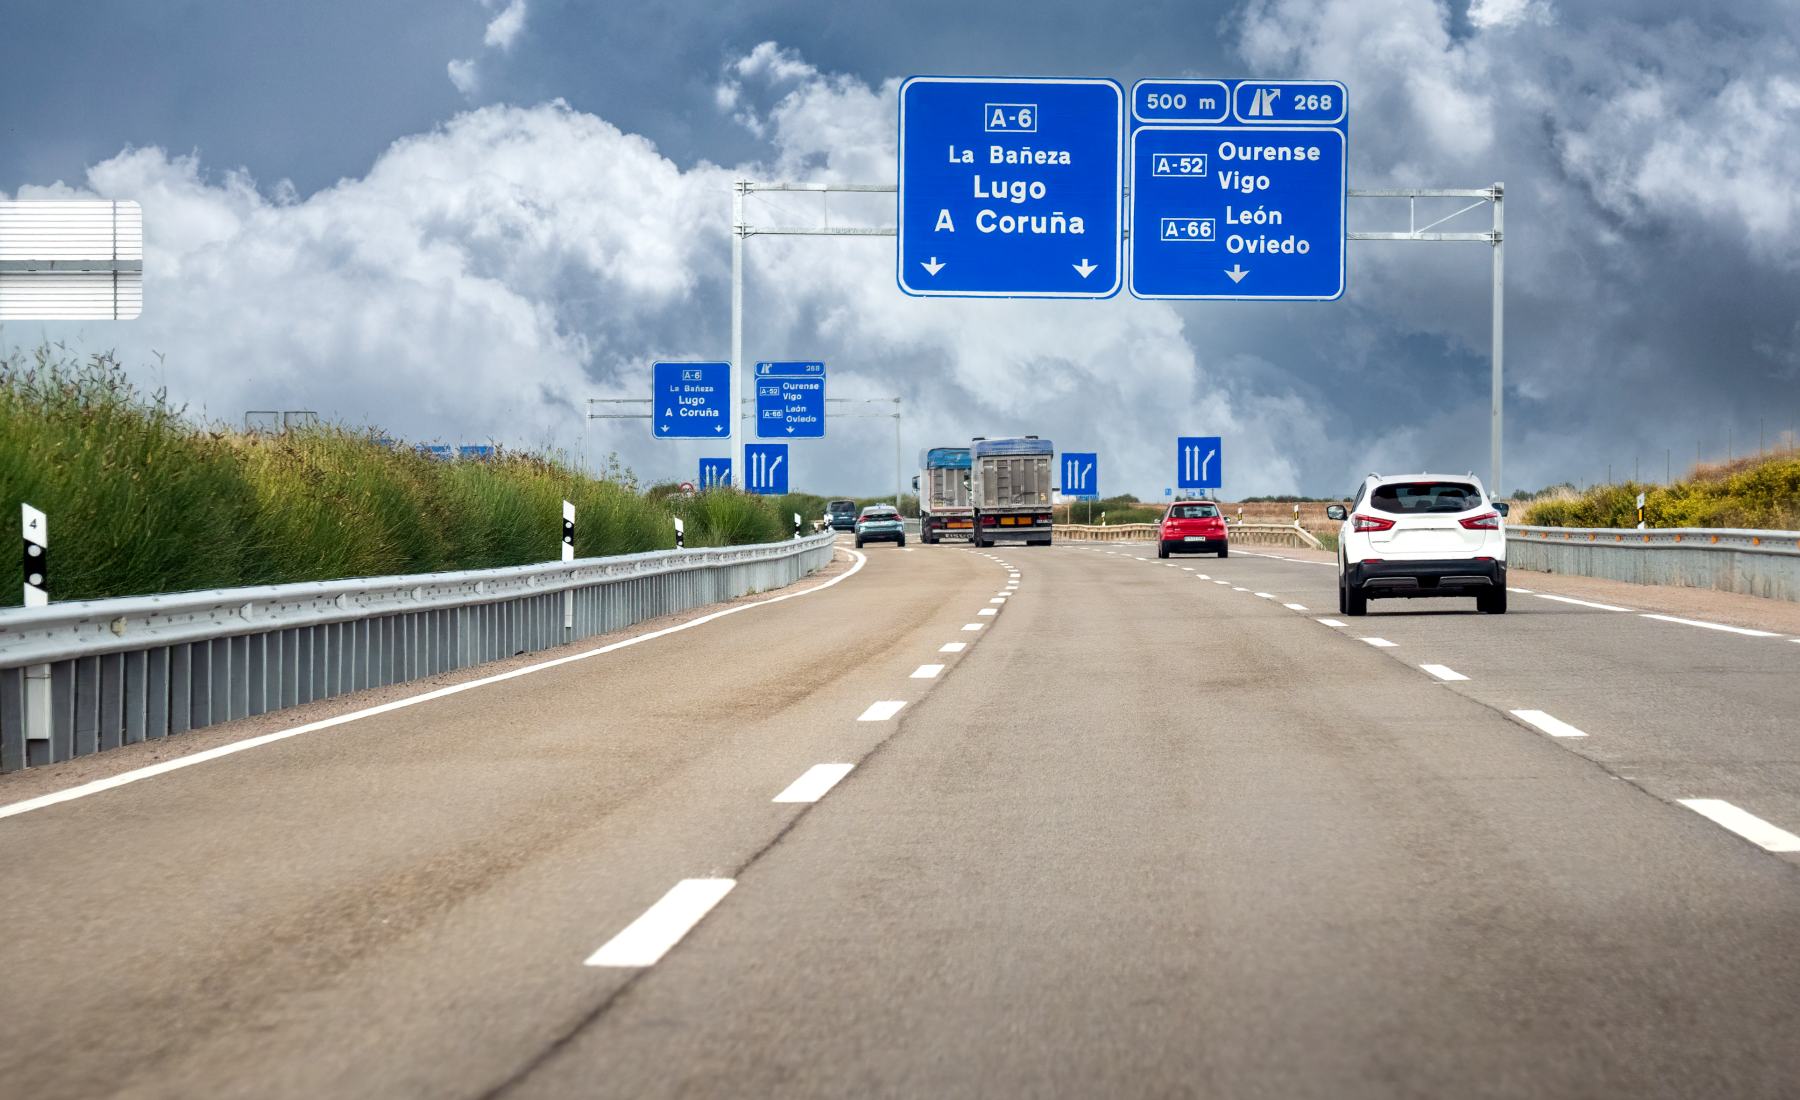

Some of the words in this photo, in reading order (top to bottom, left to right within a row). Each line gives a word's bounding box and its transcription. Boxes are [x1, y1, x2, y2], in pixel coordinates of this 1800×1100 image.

[1147, 93, 1187, 110] 500
[1199, 98, 1216, 110] m
[1294, 94, 1332, 111] 268
[990, 108, 1032, 128] A-6
[949, 145, 974, 164] La
[989, 145, 1071, 165] Bañeza
[1218, 141, 1321, 161] Ourense
[1157, 158, 1203, 174] A-52
[974, 174, 1046, 203] Lugo
[1218, 170, 1270, 193] Vigo
[934, 208, 955, 233] A
[975, 208, 1085, 234] Coruña
[1226, 205, 1282, 225] León
[1165, 221, 1212, 238] A-66
[1226, 234, 1310, 255] Oviedo
[684, 371, 700, 379] A-6
[782, 382, 820, 390] Ourense
[678, 395, 705, 406] Lugo
[782, 392, 802, 401] Vigo
[665, 408, 673, 417] A
[679, 407, 719, 417] Coruña
[786, 415, 817, 423] Oviedo
[29, 518, 37, 529] 4
